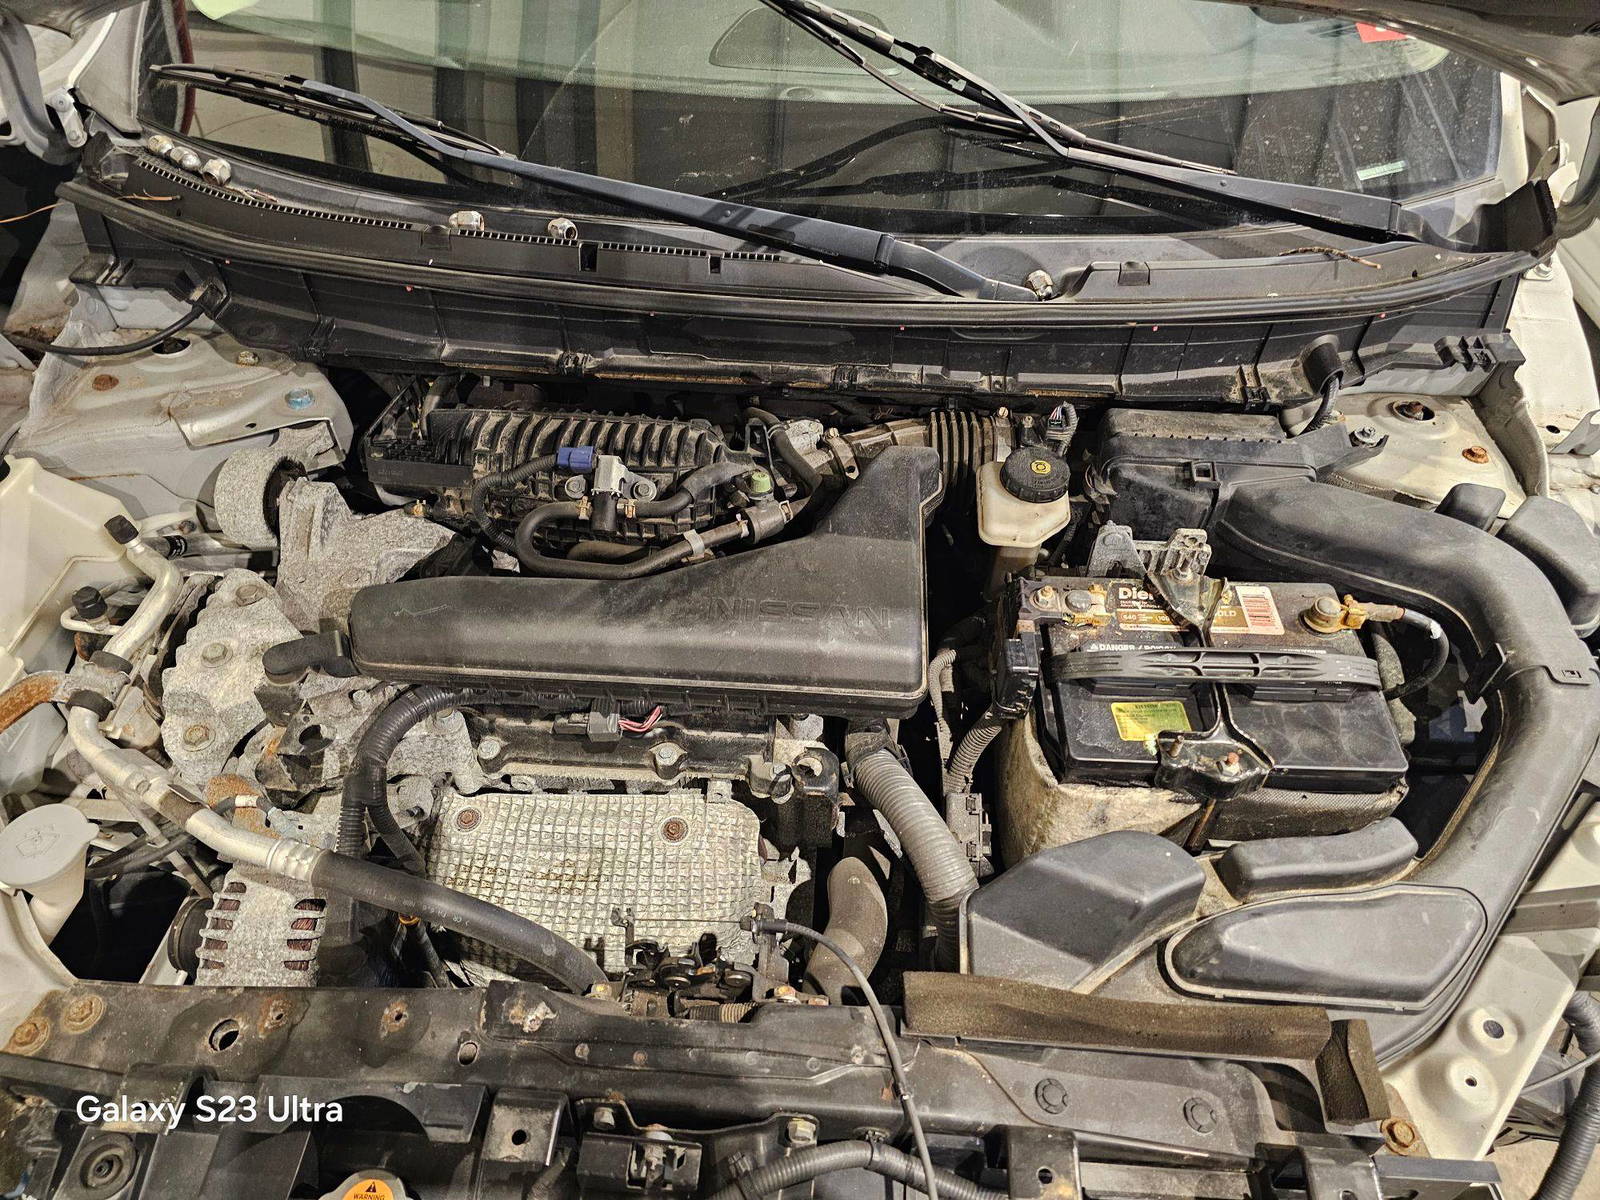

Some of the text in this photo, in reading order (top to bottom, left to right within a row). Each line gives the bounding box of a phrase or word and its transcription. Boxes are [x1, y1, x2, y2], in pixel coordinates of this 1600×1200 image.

[1118, 587, 1154, 600] Die
[708, 598, 890, 635] NISSAN
[1099, 643, 1135, 651] DANGER
